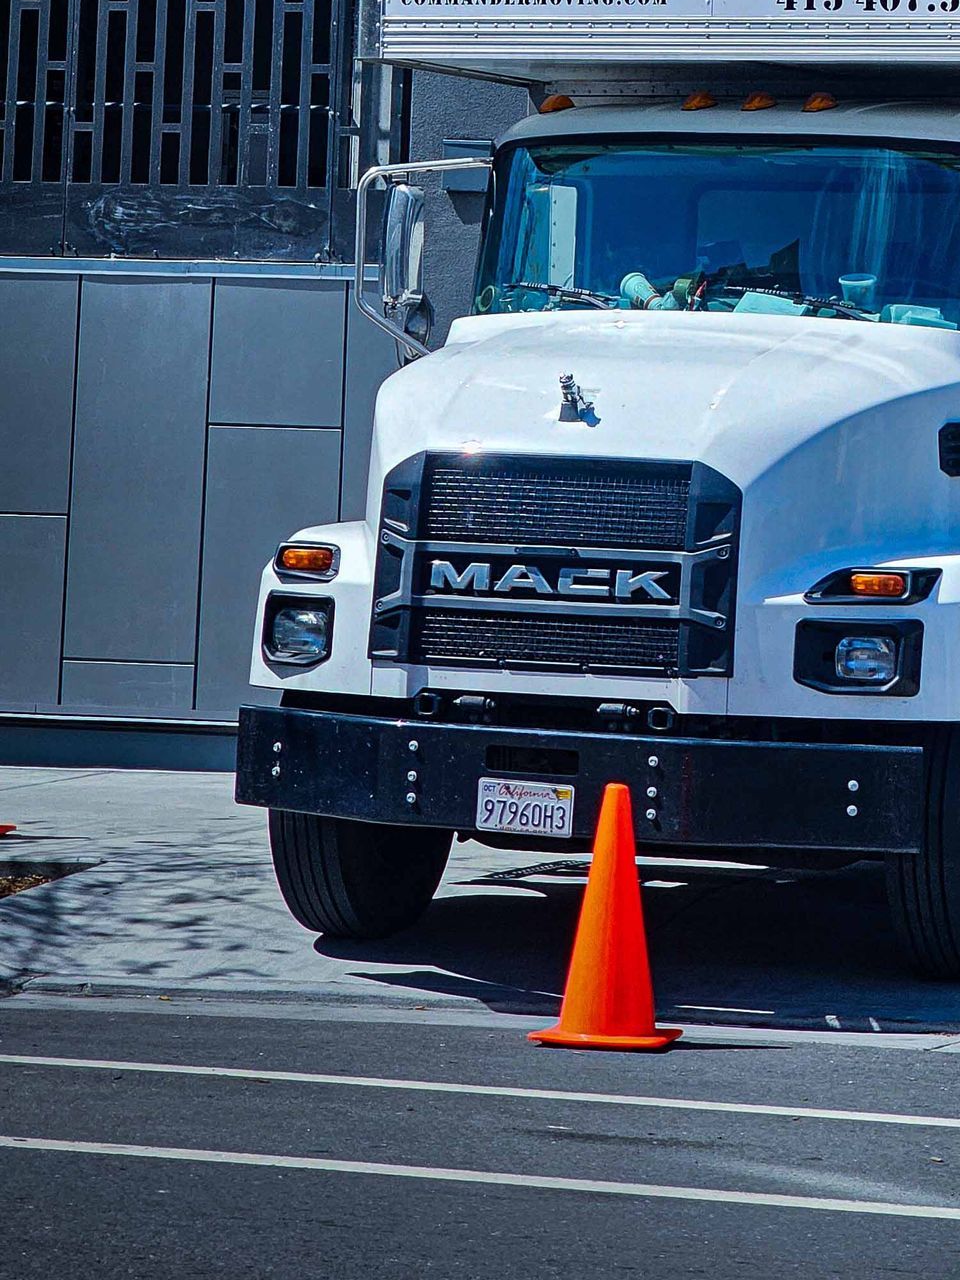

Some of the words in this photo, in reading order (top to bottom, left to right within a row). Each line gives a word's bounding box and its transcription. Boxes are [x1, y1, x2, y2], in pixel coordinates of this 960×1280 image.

[430, 560, 672, 599] MACK
[483, 784, 497, 793] OCT
[499, 782, 556, 801] California
[482, 798, 567, 831] 97960H3
